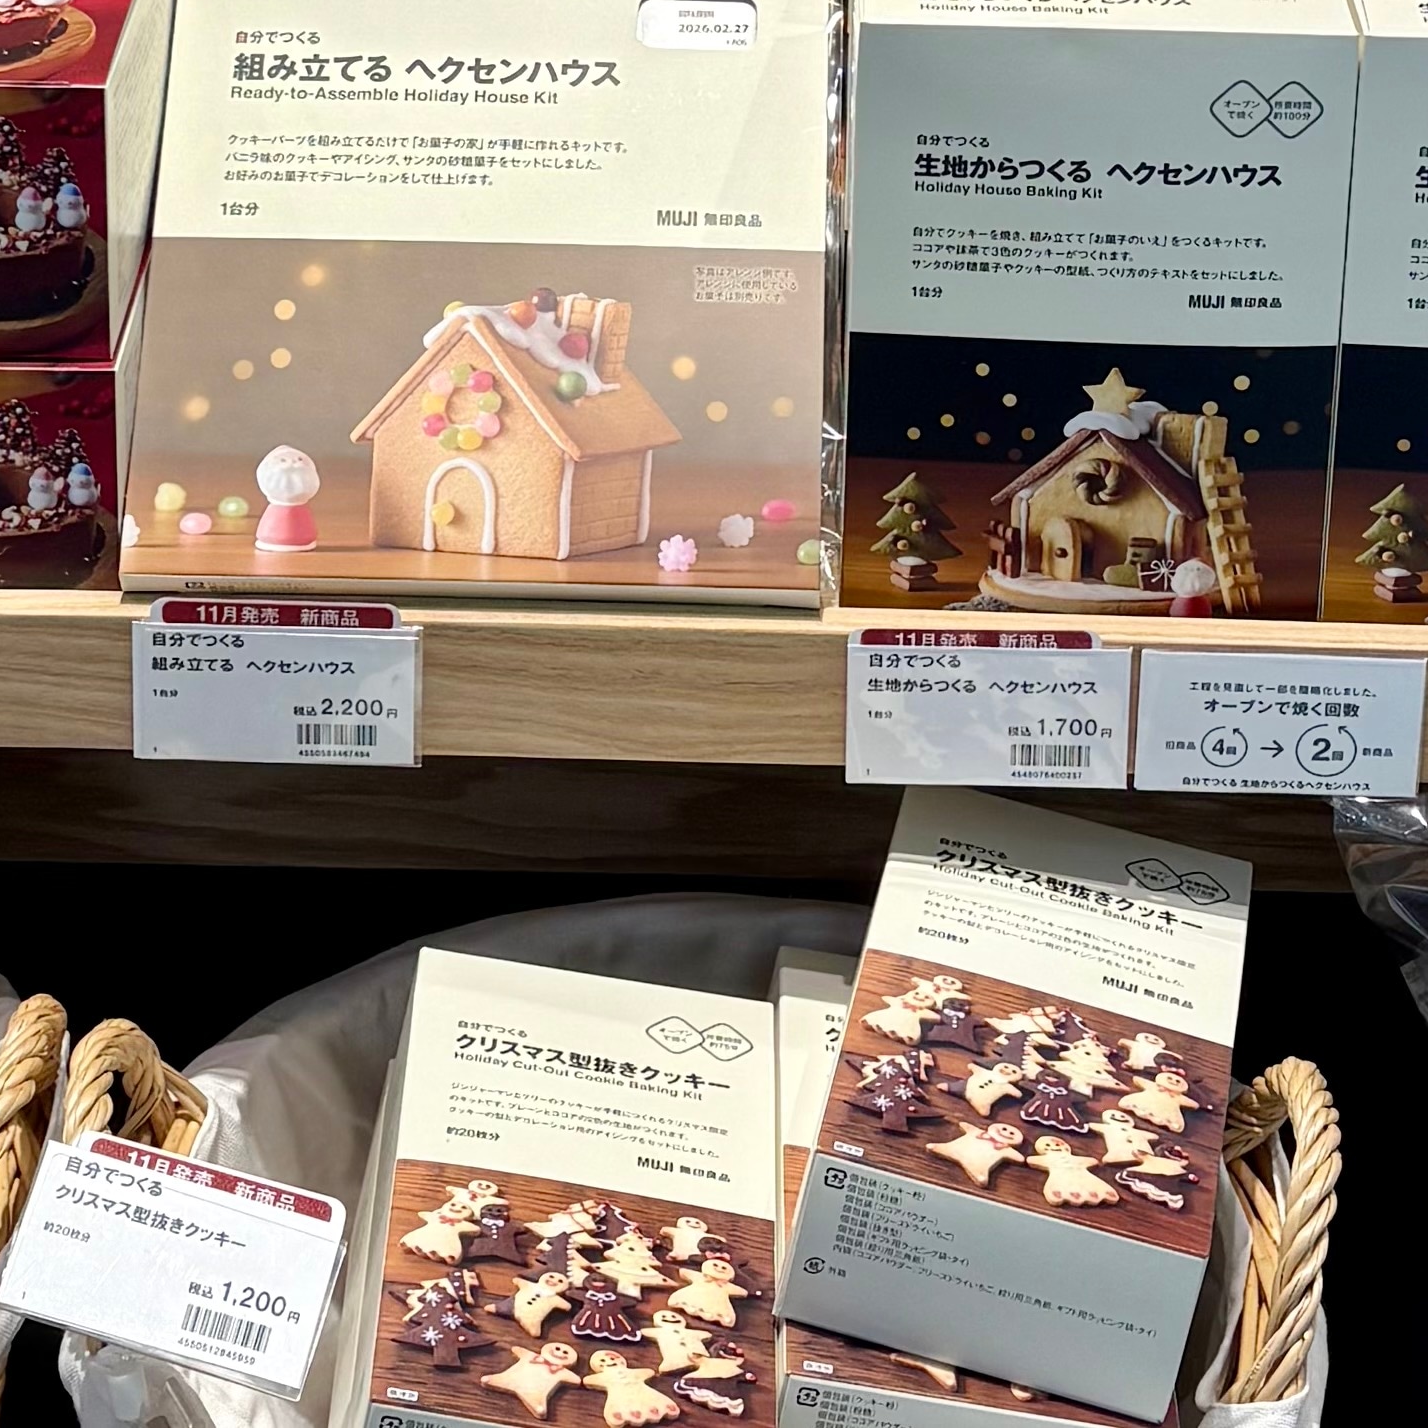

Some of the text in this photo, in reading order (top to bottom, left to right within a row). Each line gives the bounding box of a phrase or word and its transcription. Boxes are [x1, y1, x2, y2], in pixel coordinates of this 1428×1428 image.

[678, 23, 749, 35] 2026.02.27
[233, 52, 622, 88] 組み立てる ヘクセンハウス
[230, 86, 528, 106] Ready-to-Assemble Holiday House
[915, 153, 1283, 190] 生地からつくる ヘクセンハウス
[656, 208, 698, 228] MUJI
[195, 602, 281, 626] 11月発売
[152, 631, 246, 649] 自分でつくる
[152, 654, 356, 675] 組み立てる ヘクセンハウス
[868, 652, 962, 671] 自分でつくる
[868, 676, 1098, 696] 生地からつくる ヘクセンハウス
[1204, 699, 1362, 720] オーブンで焼く回数
[455, 1033, 731, 1093] クリスマス型抜きクッキー
[636, 1155, 675, 1176] MUJI
[55, 1184, 248, 1253] クリスマス型抜きクッキー
